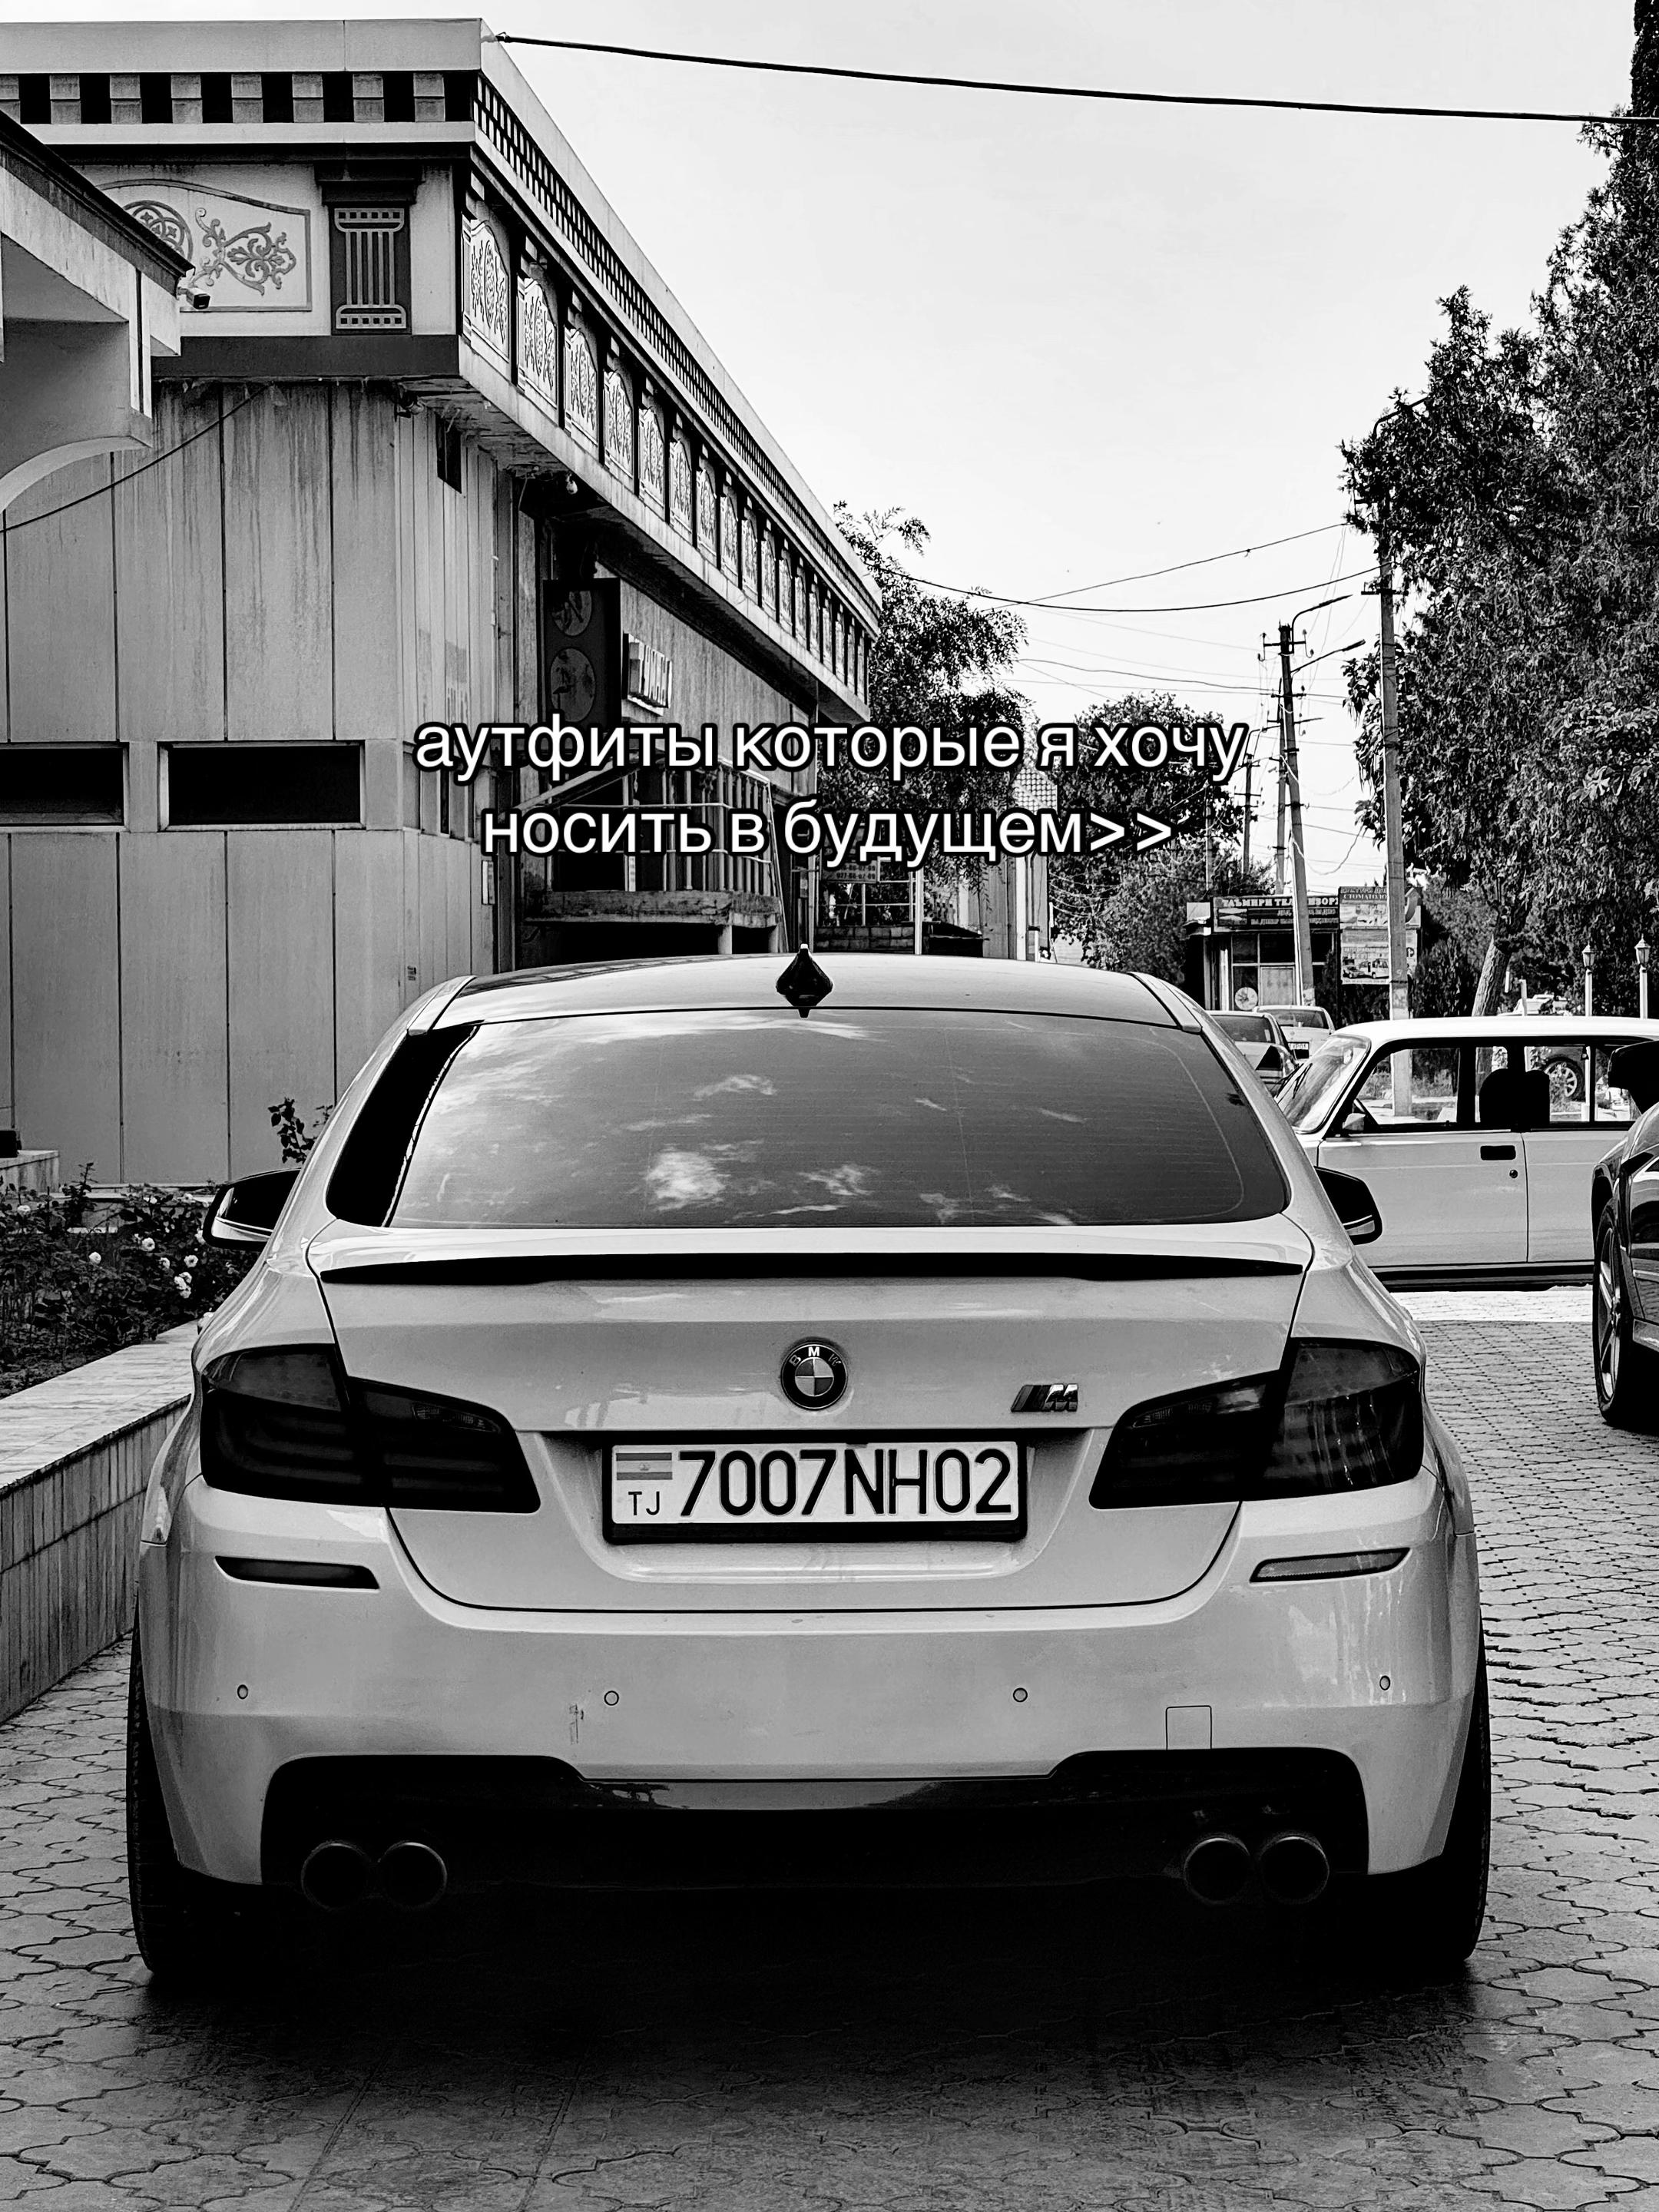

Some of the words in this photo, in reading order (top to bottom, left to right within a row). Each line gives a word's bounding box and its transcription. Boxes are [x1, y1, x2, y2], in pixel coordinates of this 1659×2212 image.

[789, 1346, 842, 1367] BMW
[628, 1491, 661, 1516] TJ
[679, 1448, 1012, 1518] 7007NH02
